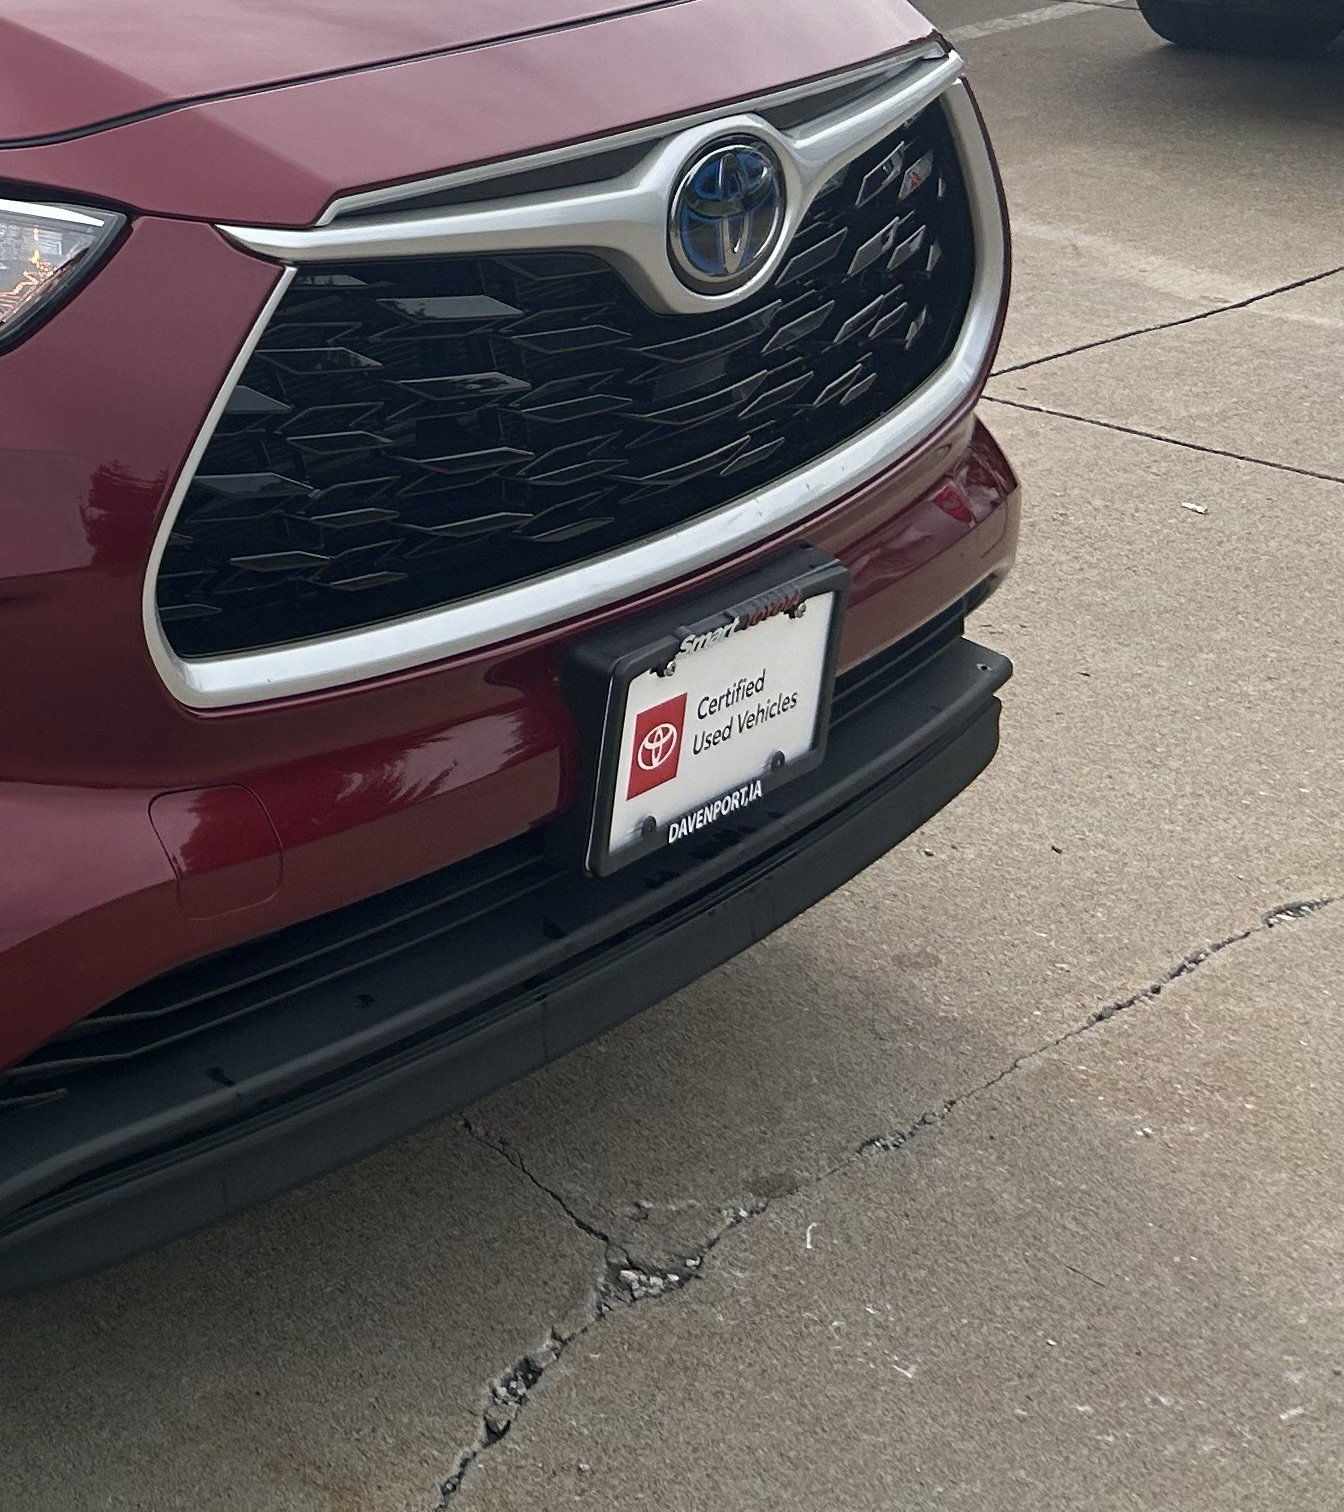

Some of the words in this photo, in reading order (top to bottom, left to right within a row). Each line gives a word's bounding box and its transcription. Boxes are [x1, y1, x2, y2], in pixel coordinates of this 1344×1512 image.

[692, 721, 733, 755] Used
[737, 690, 799, 732] Vehicles
[697, 668, 766, 720] Certified
